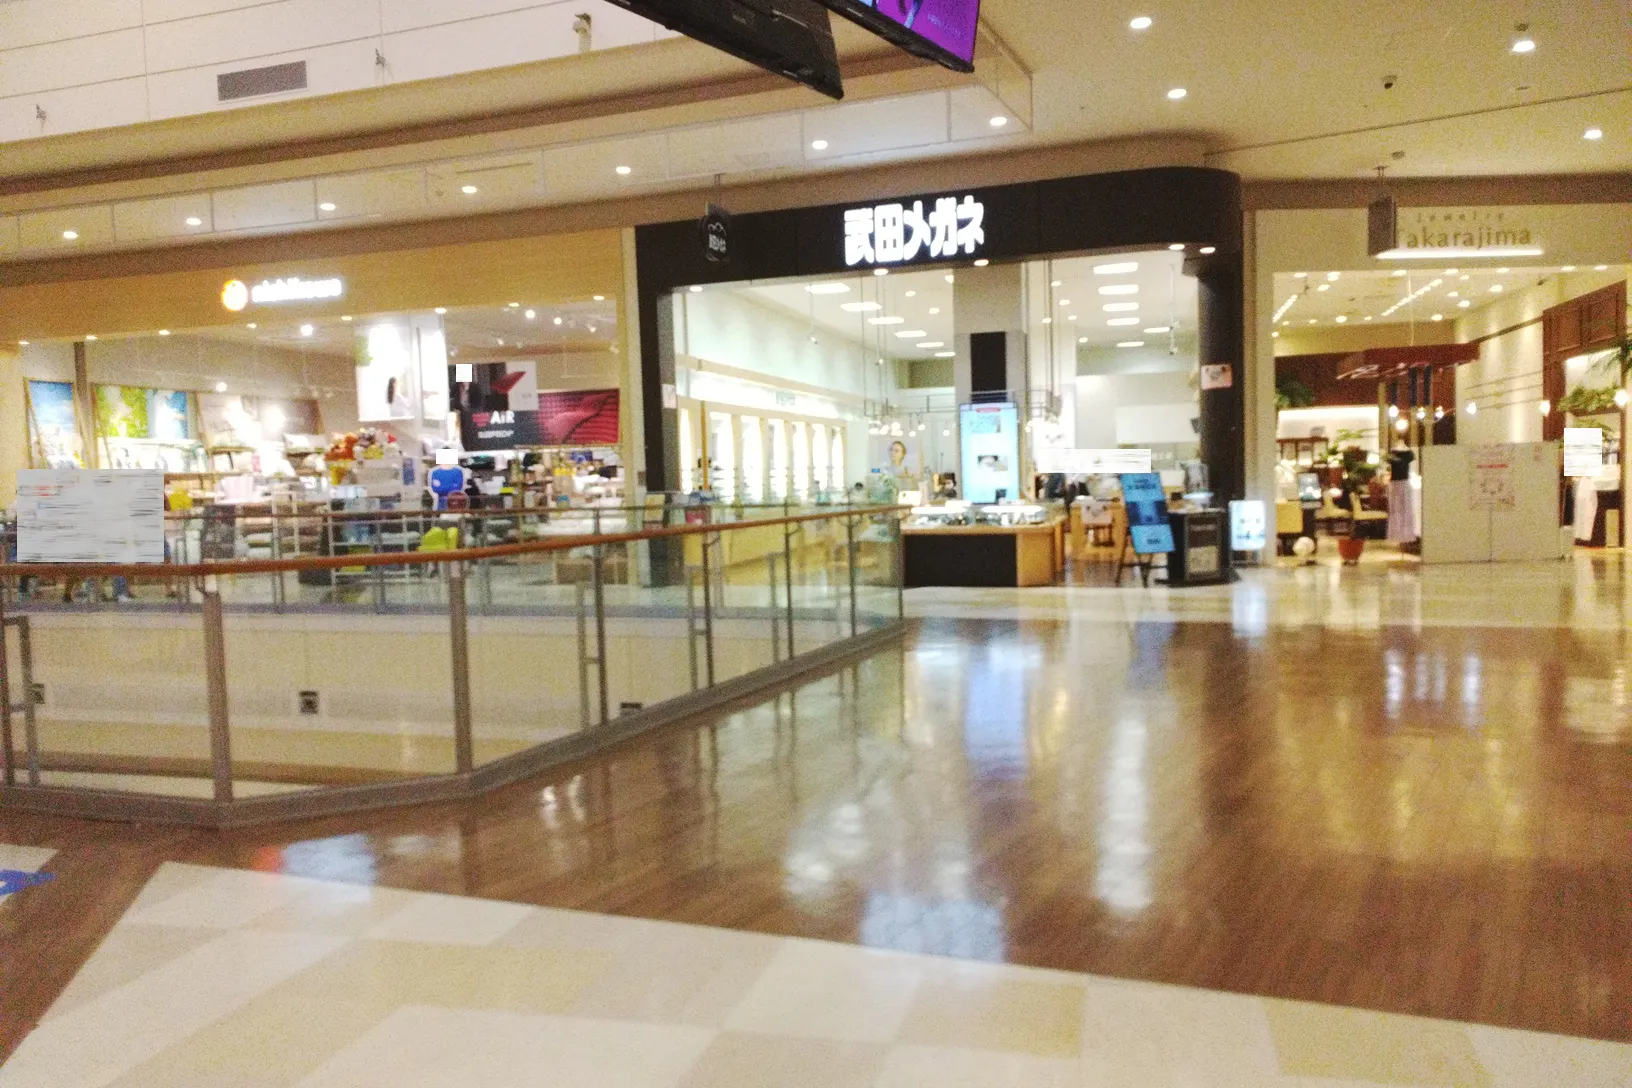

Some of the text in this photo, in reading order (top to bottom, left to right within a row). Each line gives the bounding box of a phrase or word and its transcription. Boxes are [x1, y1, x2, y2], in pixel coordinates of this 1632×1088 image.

[844, 195, 985, 266] 武田メガネ
